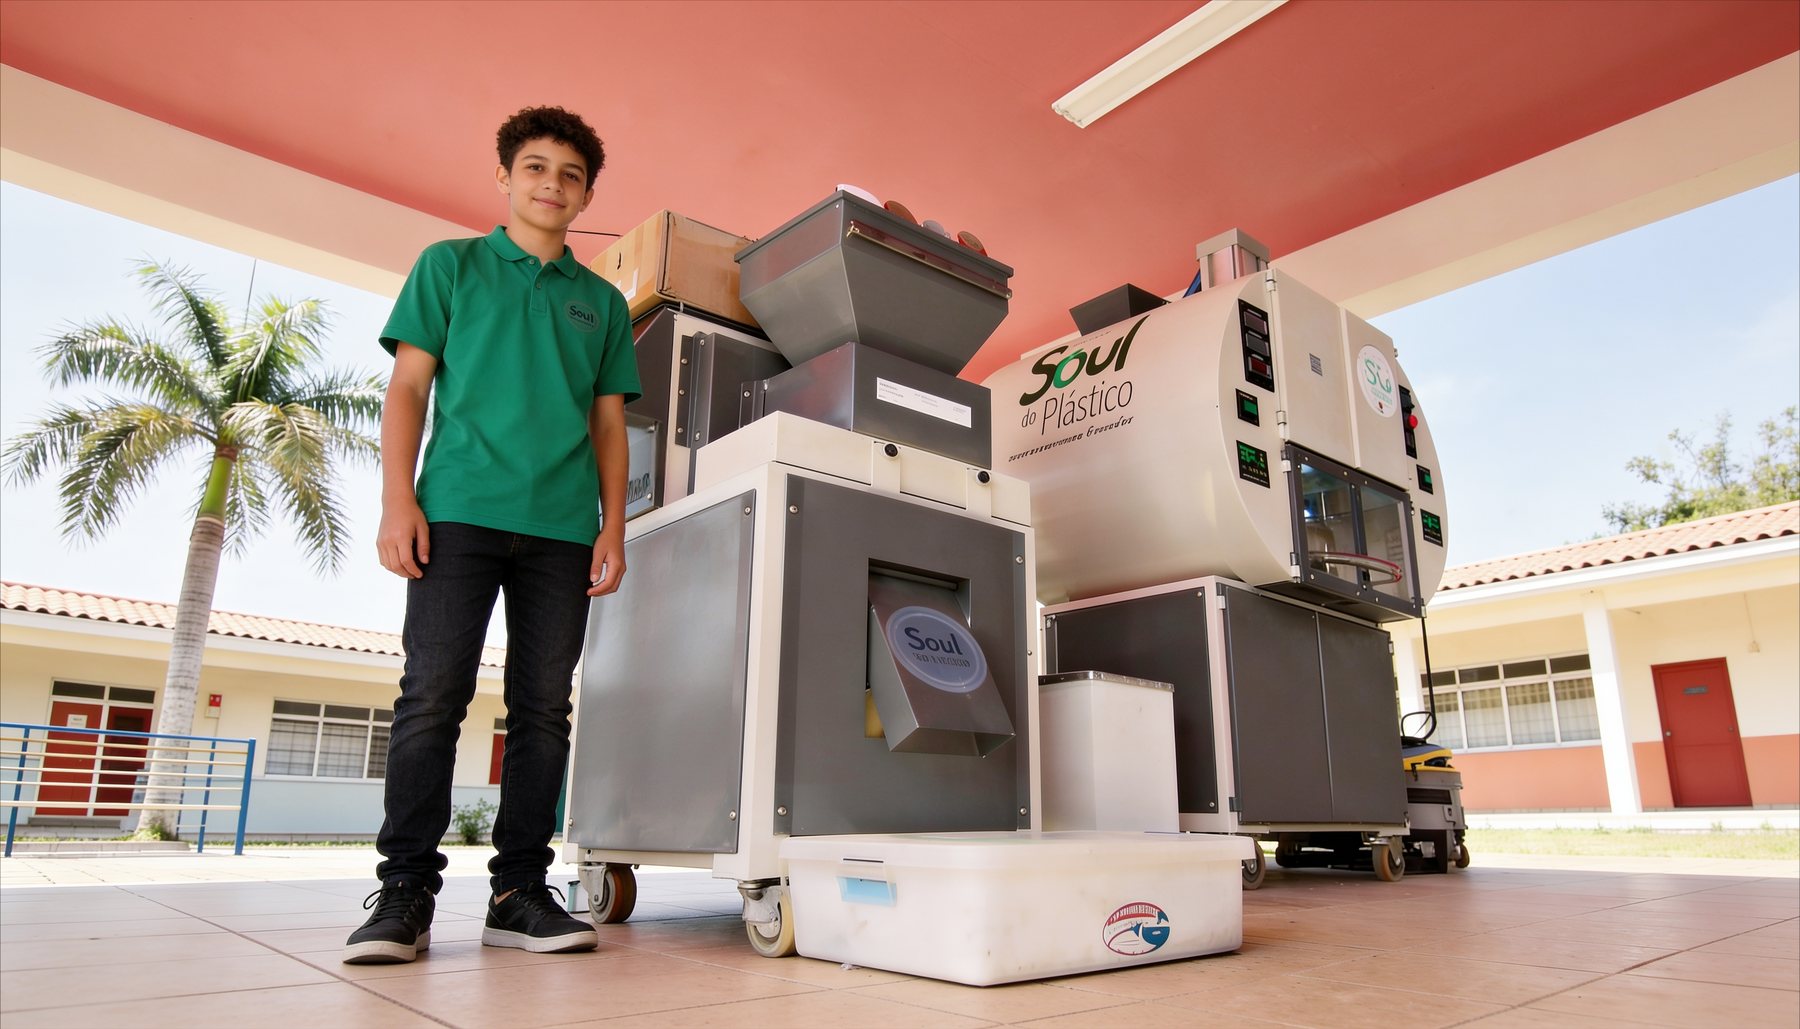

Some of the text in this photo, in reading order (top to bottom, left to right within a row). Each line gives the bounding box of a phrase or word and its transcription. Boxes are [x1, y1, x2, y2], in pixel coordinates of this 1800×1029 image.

[569, 305, 594, 324] Soul
[1021, 380, 1133, 435] do Plástico
[904, 626, 963, 655] Soul
